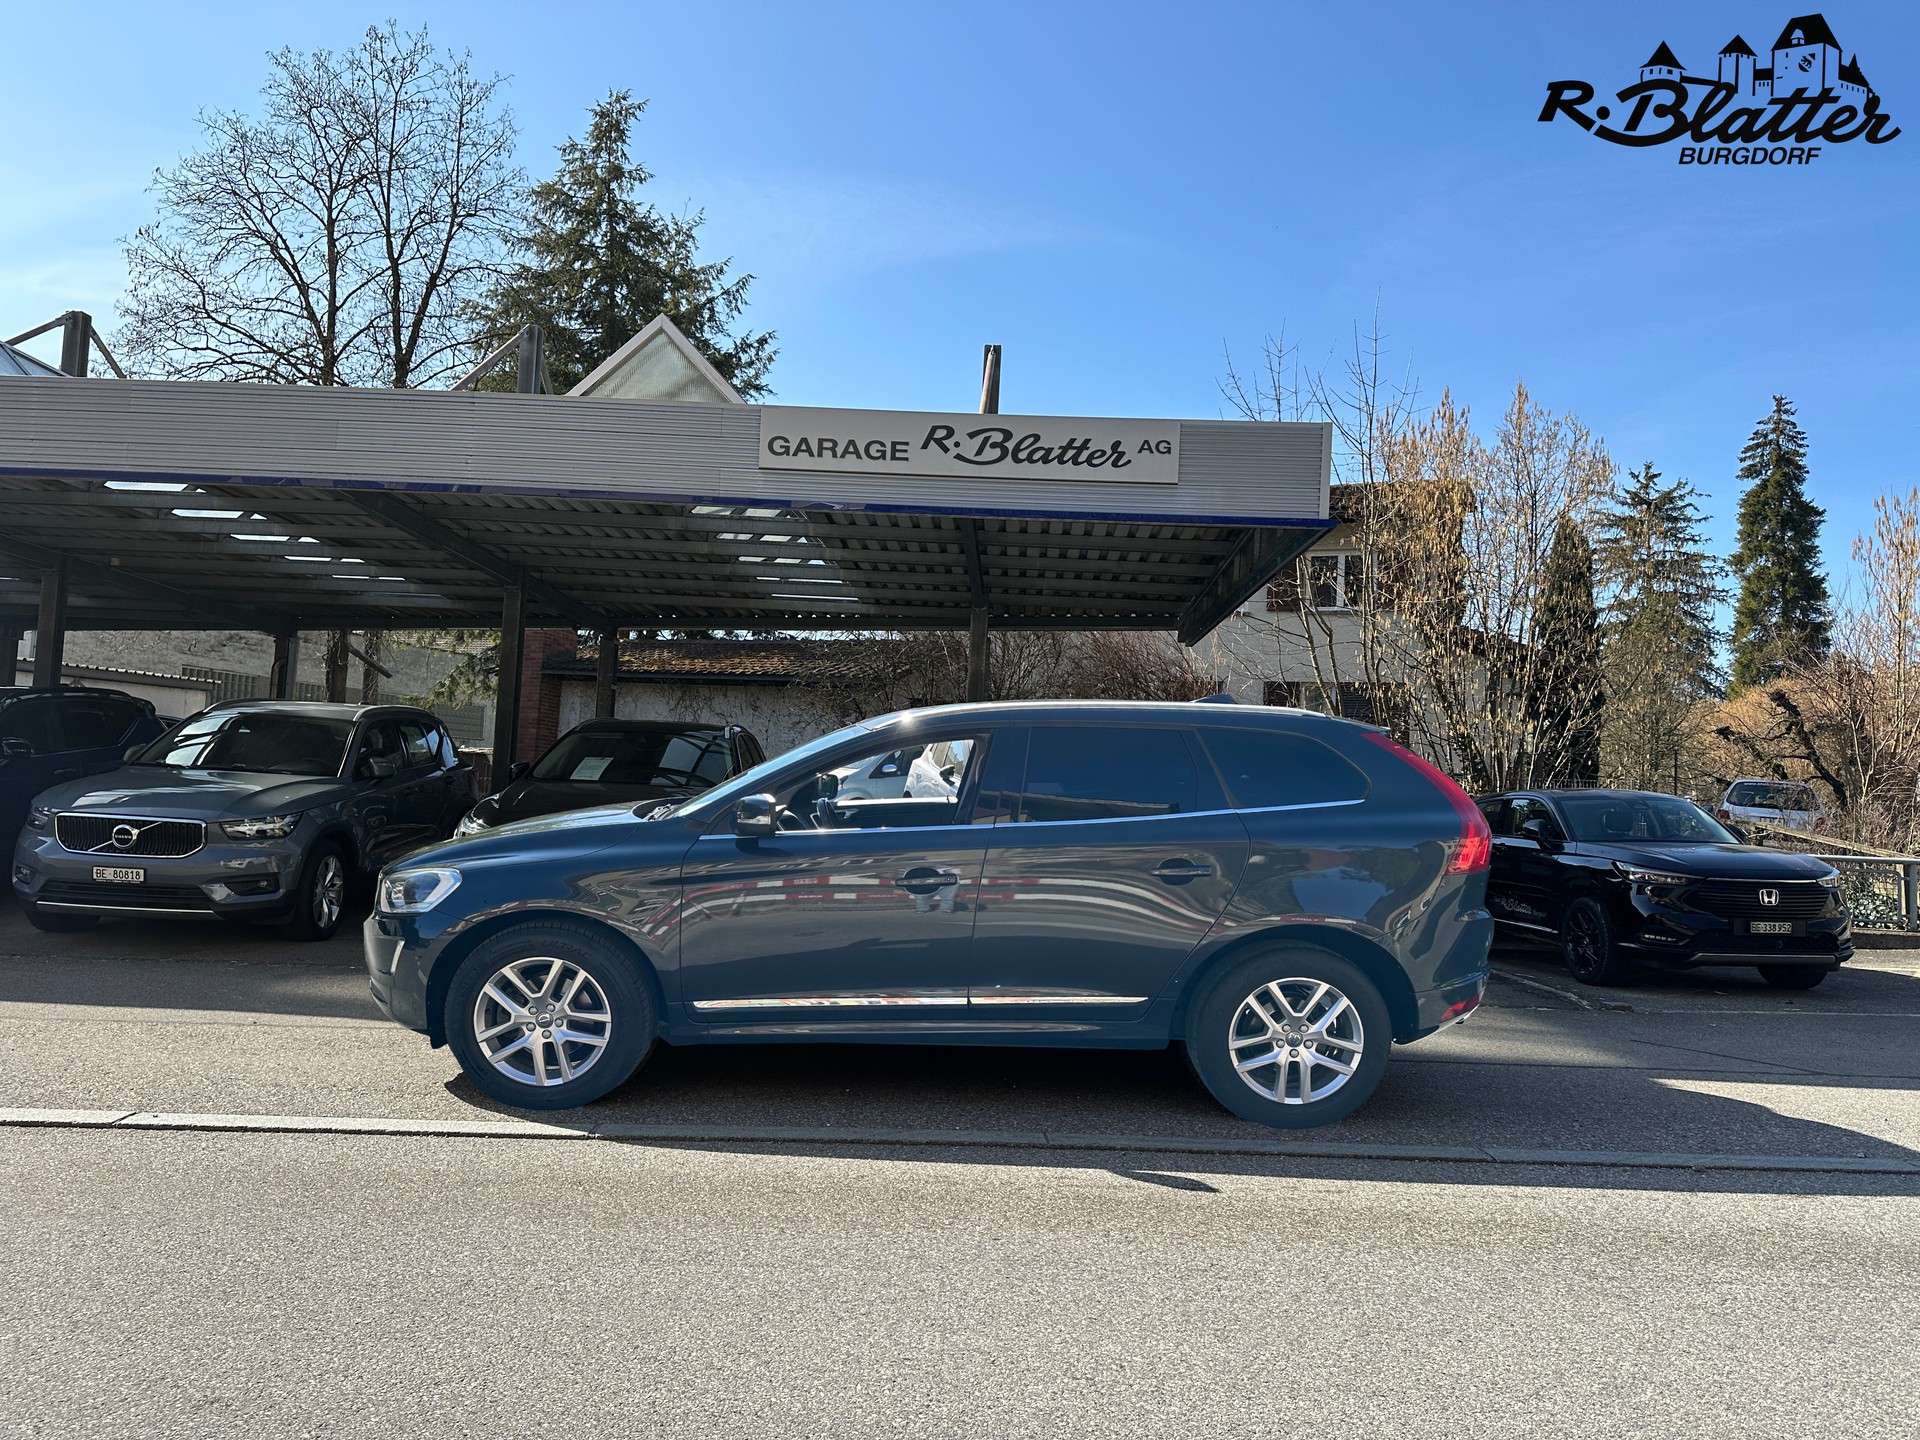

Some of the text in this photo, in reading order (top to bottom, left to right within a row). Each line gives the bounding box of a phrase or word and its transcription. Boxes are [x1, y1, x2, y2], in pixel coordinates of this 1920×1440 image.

[767, 435, 910, 462] GARAGE
[1138, 439, 1172, 455] AG
[542, 939, 592, 960] ULTRAC
